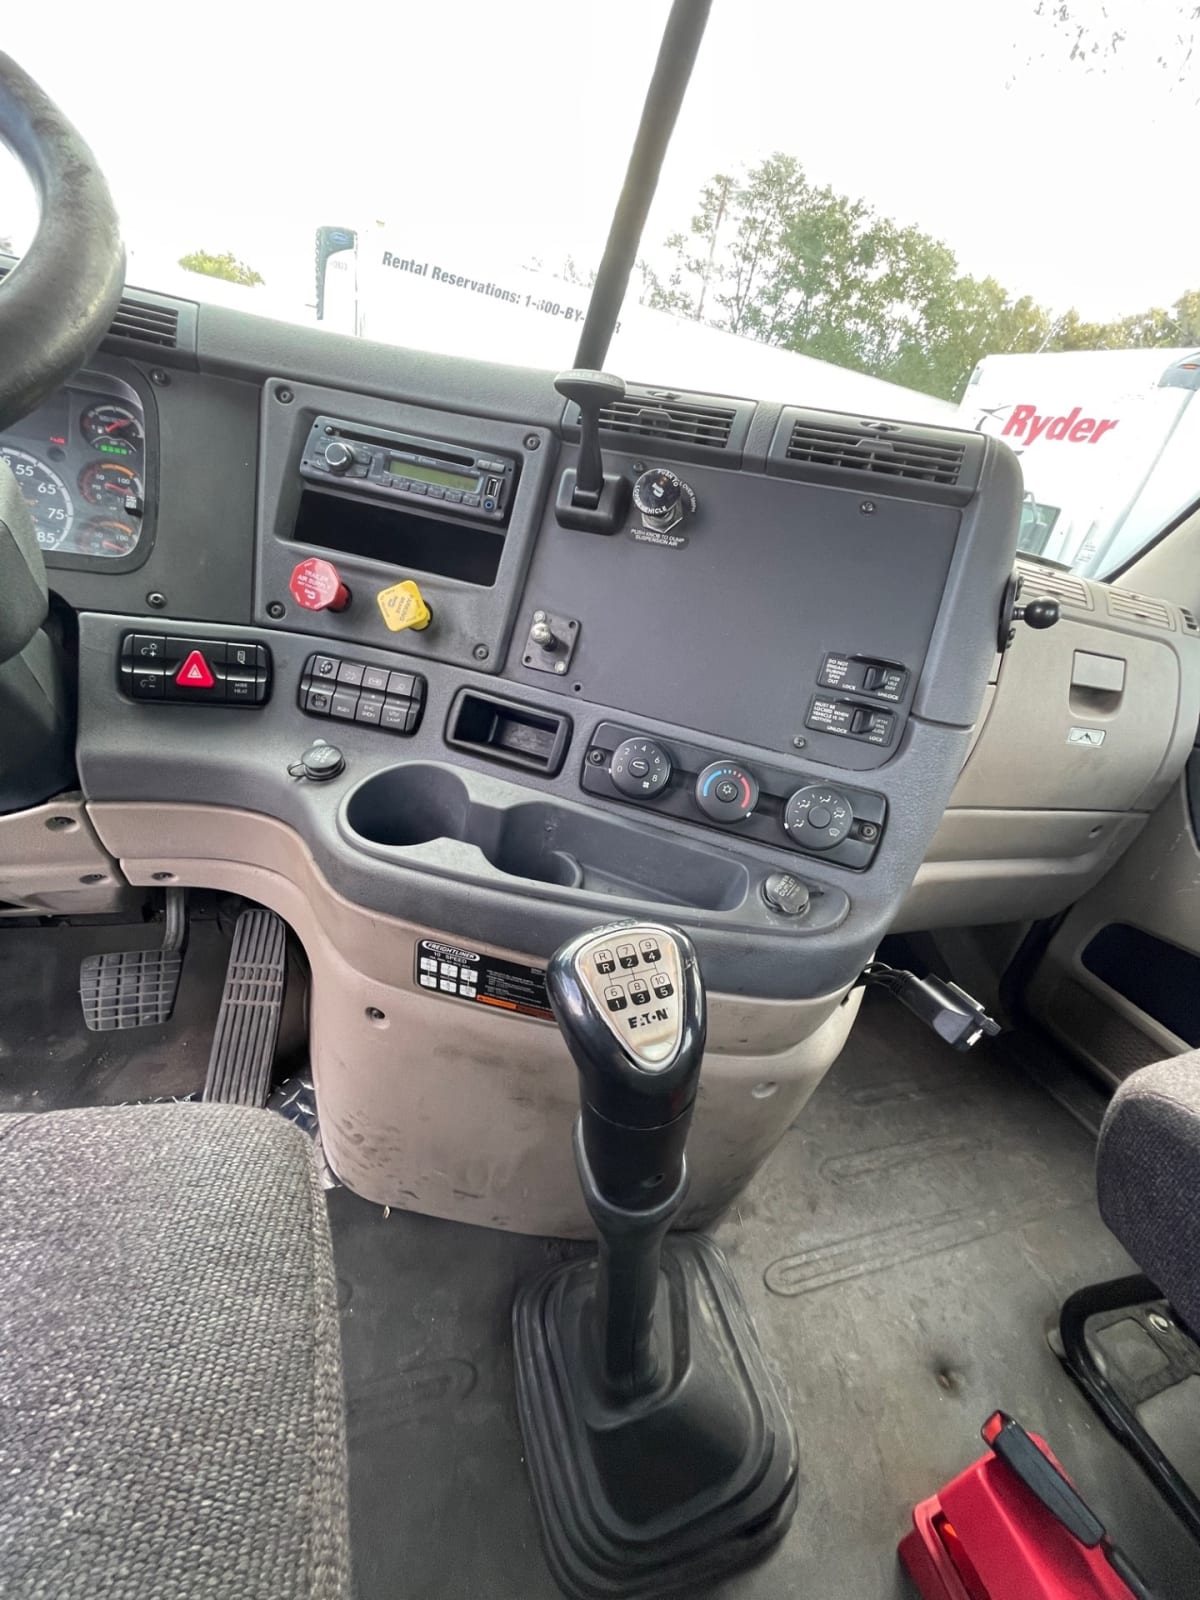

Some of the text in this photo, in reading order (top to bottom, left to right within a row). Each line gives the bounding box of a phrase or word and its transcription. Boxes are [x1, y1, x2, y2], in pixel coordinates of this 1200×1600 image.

[382, 251, 428, 277] Rental
[431, 266, 521, 304] Reservations:
[1001, 404, 1120, 446] Ryder
[15, 464, 34, 477] 55
[37, 482, 57, 495] 65
[47, 507, 65, 520] 75
[36, 531, 56, 543] 85
[842, 683, 856, 691] LOCK
[877, 692, 899, 700] UNLOCK
[812, 711, 832, 719] VEHICLE
[814, 706, 849, 718] LOCKED WHEN
[811, 716, 832, 724] MOTION
[826, 725, 848, 734] UNLOCK
[624, 747, 630, 755] 2
[641, 744, 647, 752] 4
[654, 756, 660, 764] 6
[652, 774, 658, 782] 8
[622, 946, 629, 954] 7
[645, 941, 652, 950] 9
[427, 942, 475, 959] FREIGHTLINER
[598, 952, 607, 961] R
[648, 952, 656, 961] 4
[626, 958, 633, 967] 2
[602, 963, 611, 972] R
[654, 975, 665, 985] 10
[633, 982, 641, 990] 8
[611, 988, 618, 997] 6
[660, 987, 668, 996] 5
[637, 994, 645, 1002] 3
[615, 1000, 620, 1009] 1
